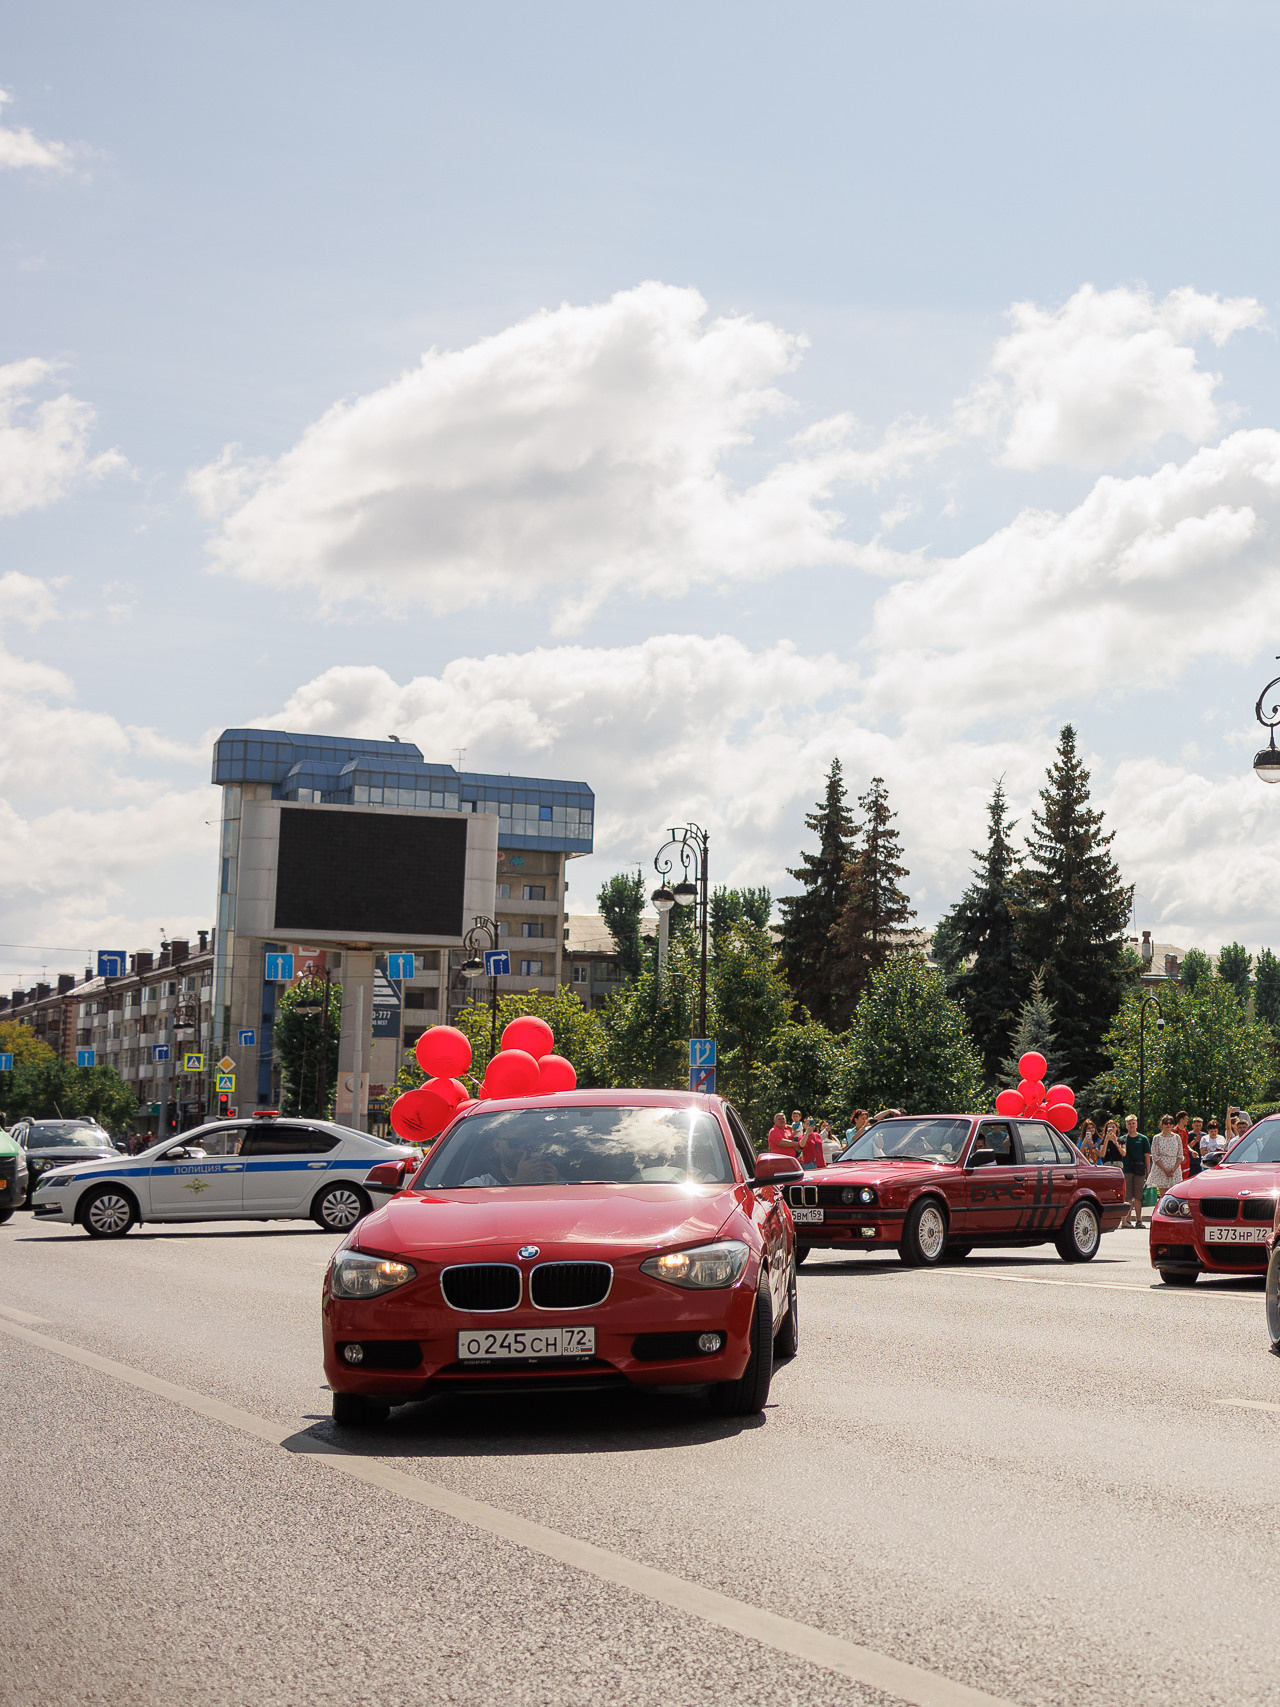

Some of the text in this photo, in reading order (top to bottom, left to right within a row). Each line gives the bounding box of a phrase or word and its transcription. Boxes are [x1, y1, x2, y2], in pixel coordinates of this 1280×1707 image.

[173, 1164, 222, 1174] ПОЛИЦИЯ
[1209, 1228, 1268, 1241] Е373НР 72
[467, 1329, 588, 1355] О245СН 72
